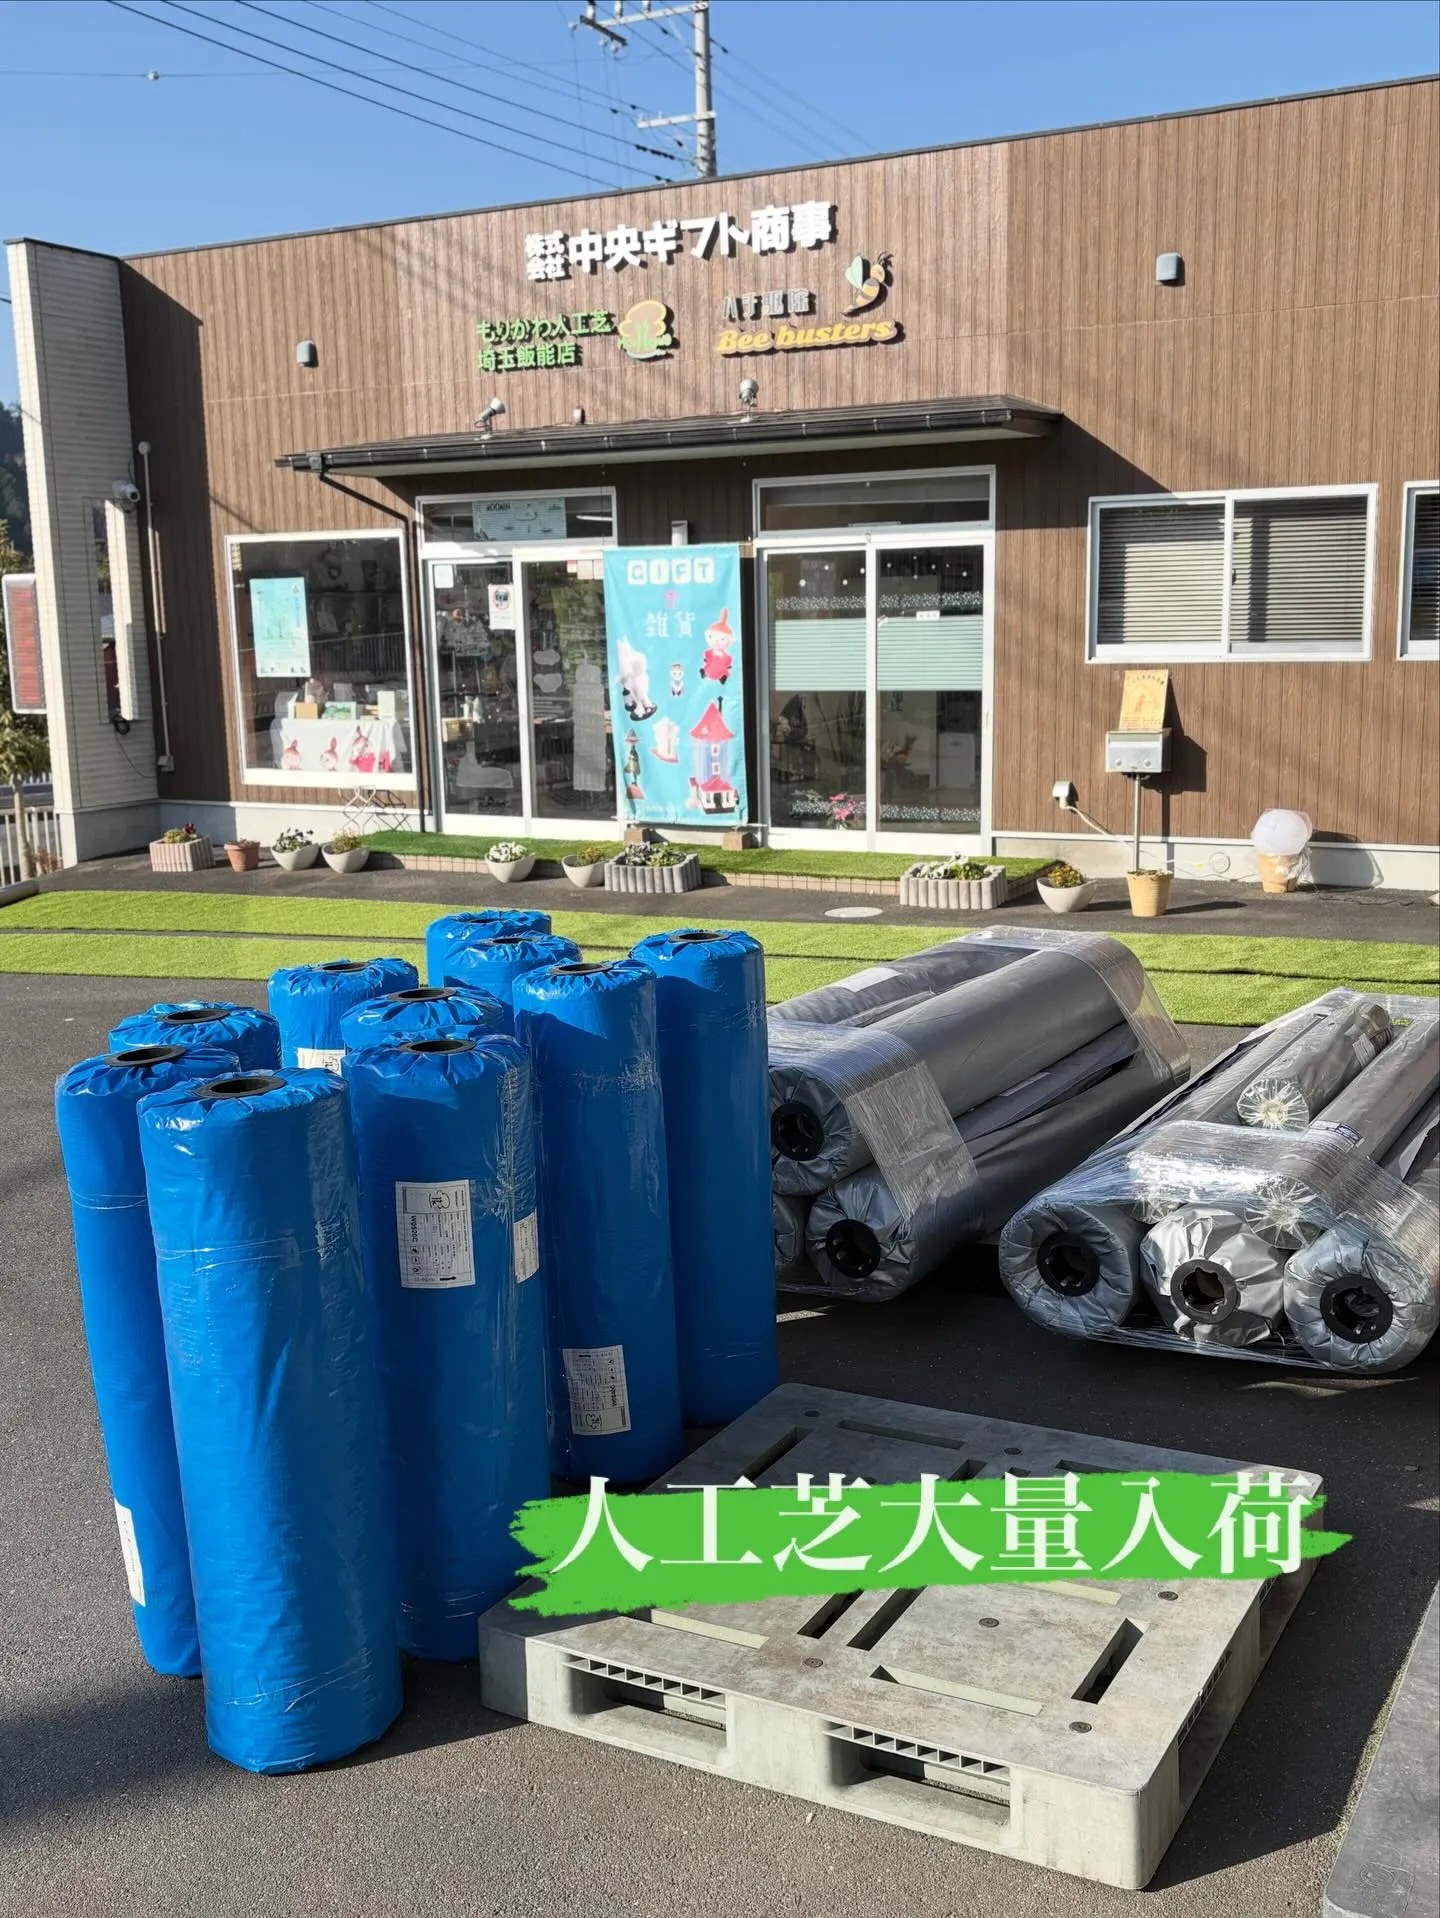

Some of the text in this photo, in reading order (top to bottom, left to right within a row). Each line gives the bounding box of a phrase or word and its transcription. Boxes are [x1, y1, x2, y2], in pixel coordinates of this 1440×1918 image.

[568, 200, 832, 273] 中央ギフト商事
[476, 309, 613, 341] もりかわ人工芝
[718, 320, 896, 352] Bee busters
[477, 342, 577, 371] 埼玉飯能店
[630, 560, 712, 583] GIFT
